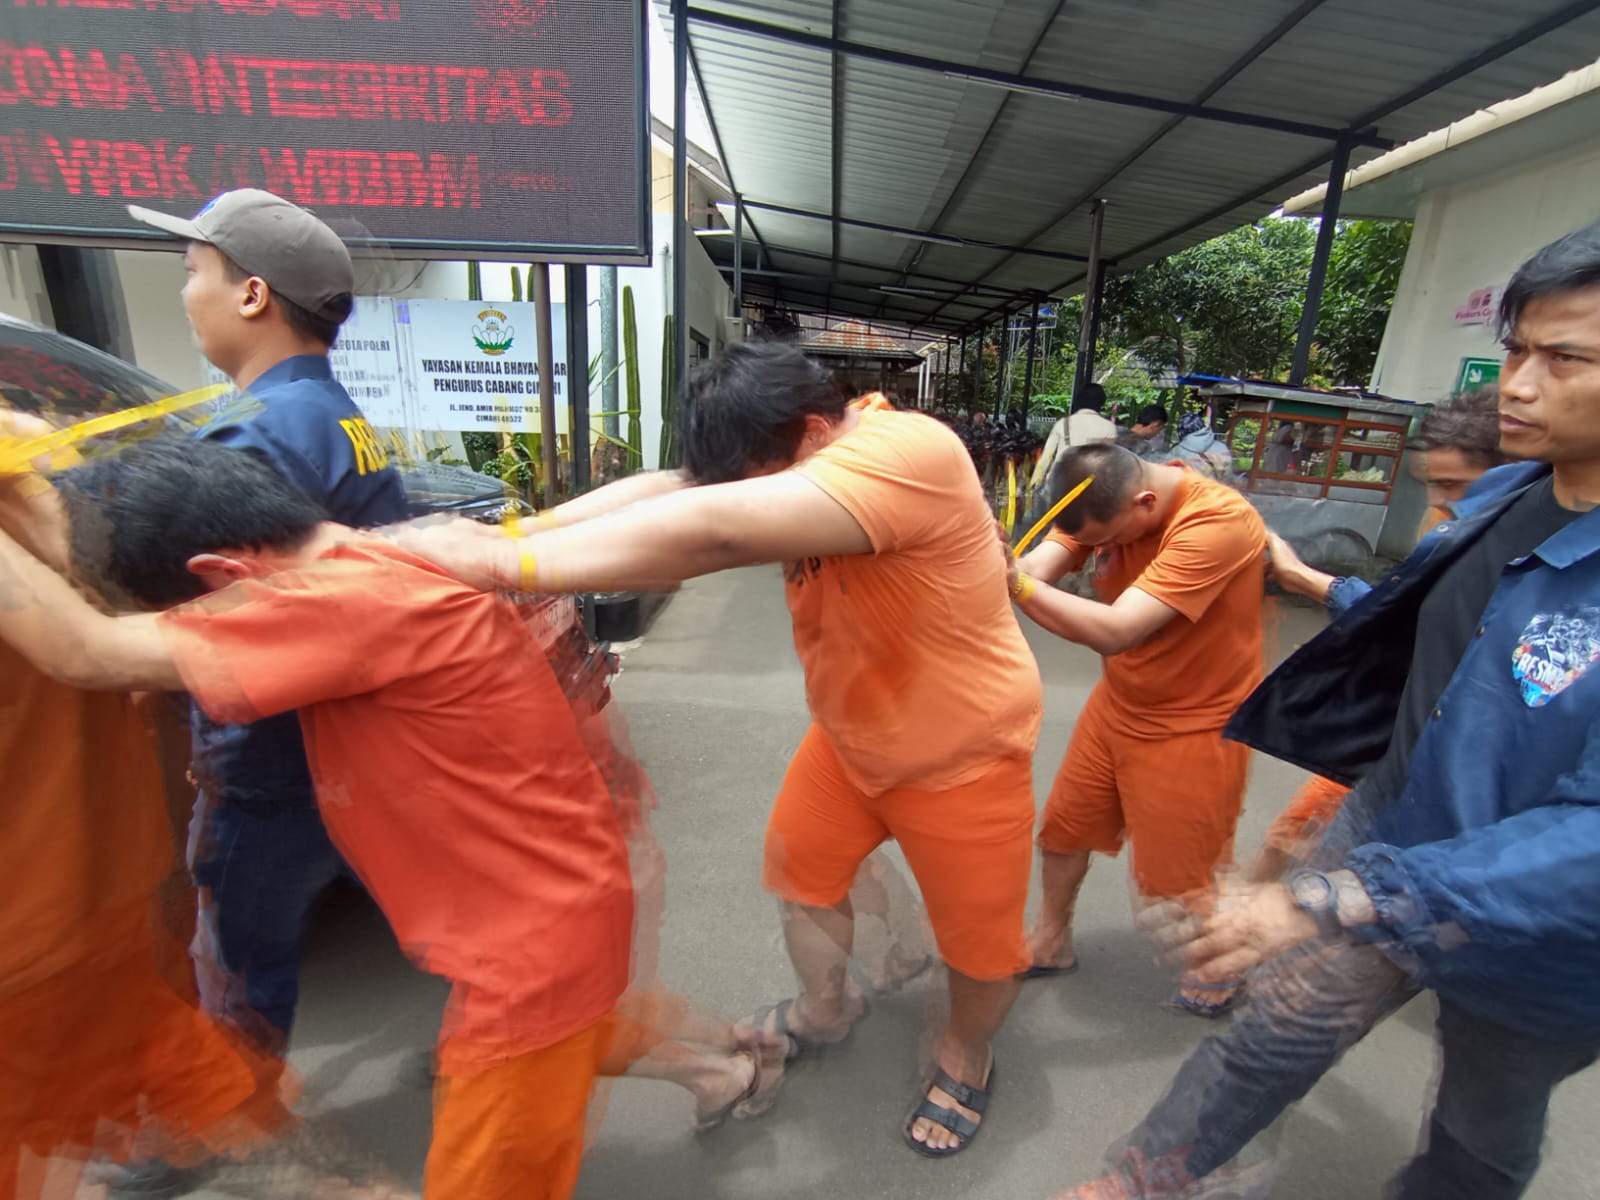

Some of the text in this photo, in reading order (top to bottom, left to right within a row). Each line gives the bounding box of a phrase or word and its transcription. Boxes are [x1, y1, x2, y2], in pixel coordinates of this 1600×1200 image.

[168, 52, 574, 126] INTEGRITAS
[422, 359, 567, 376] YAYASAN KEMALA BHAYANAR
[434, 378, 483, 392] PENGURUS
[485, 380, 524, 394] CABANG
[476, 415, 500, 423] CIMAHI
